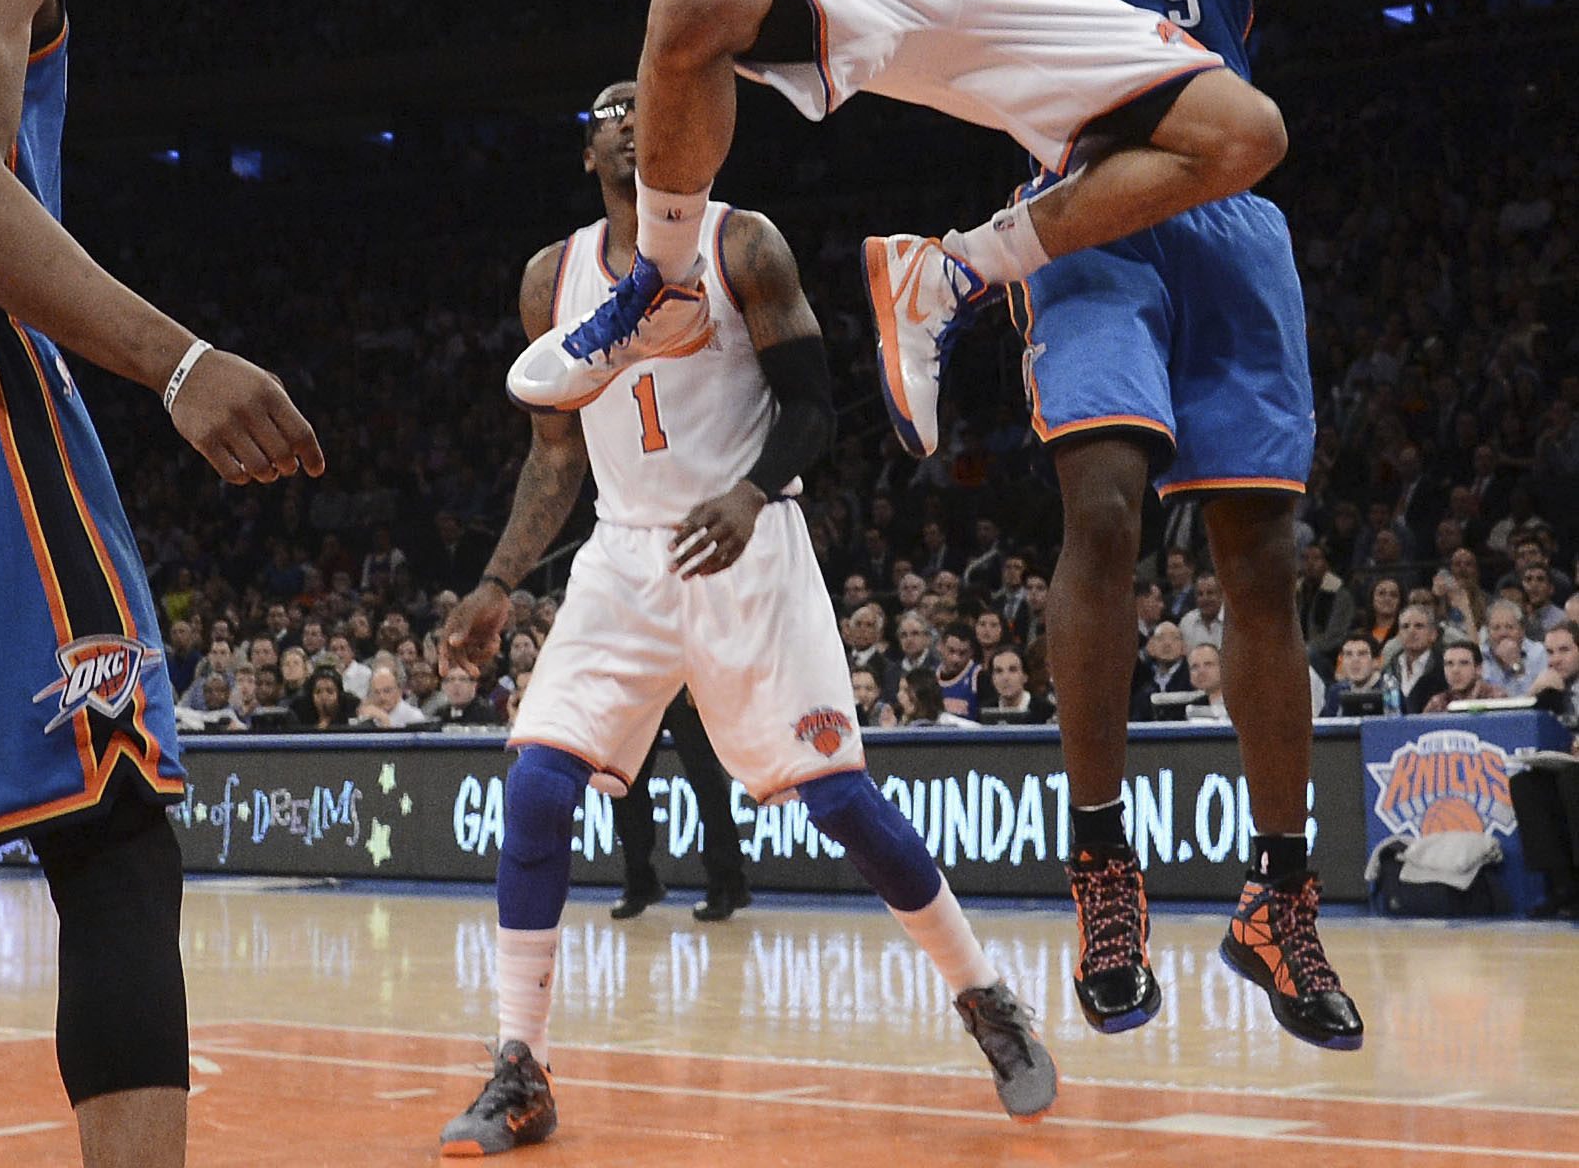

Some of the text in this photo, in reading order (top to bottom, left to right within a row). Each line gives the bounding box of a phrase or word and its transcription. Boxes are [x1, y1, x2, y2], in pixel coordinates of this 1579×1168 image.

[631, 372, 669, 454] 1
[64, 650, 126, 706] OKC
[1382, 750, 1514, 812] KNICKS
